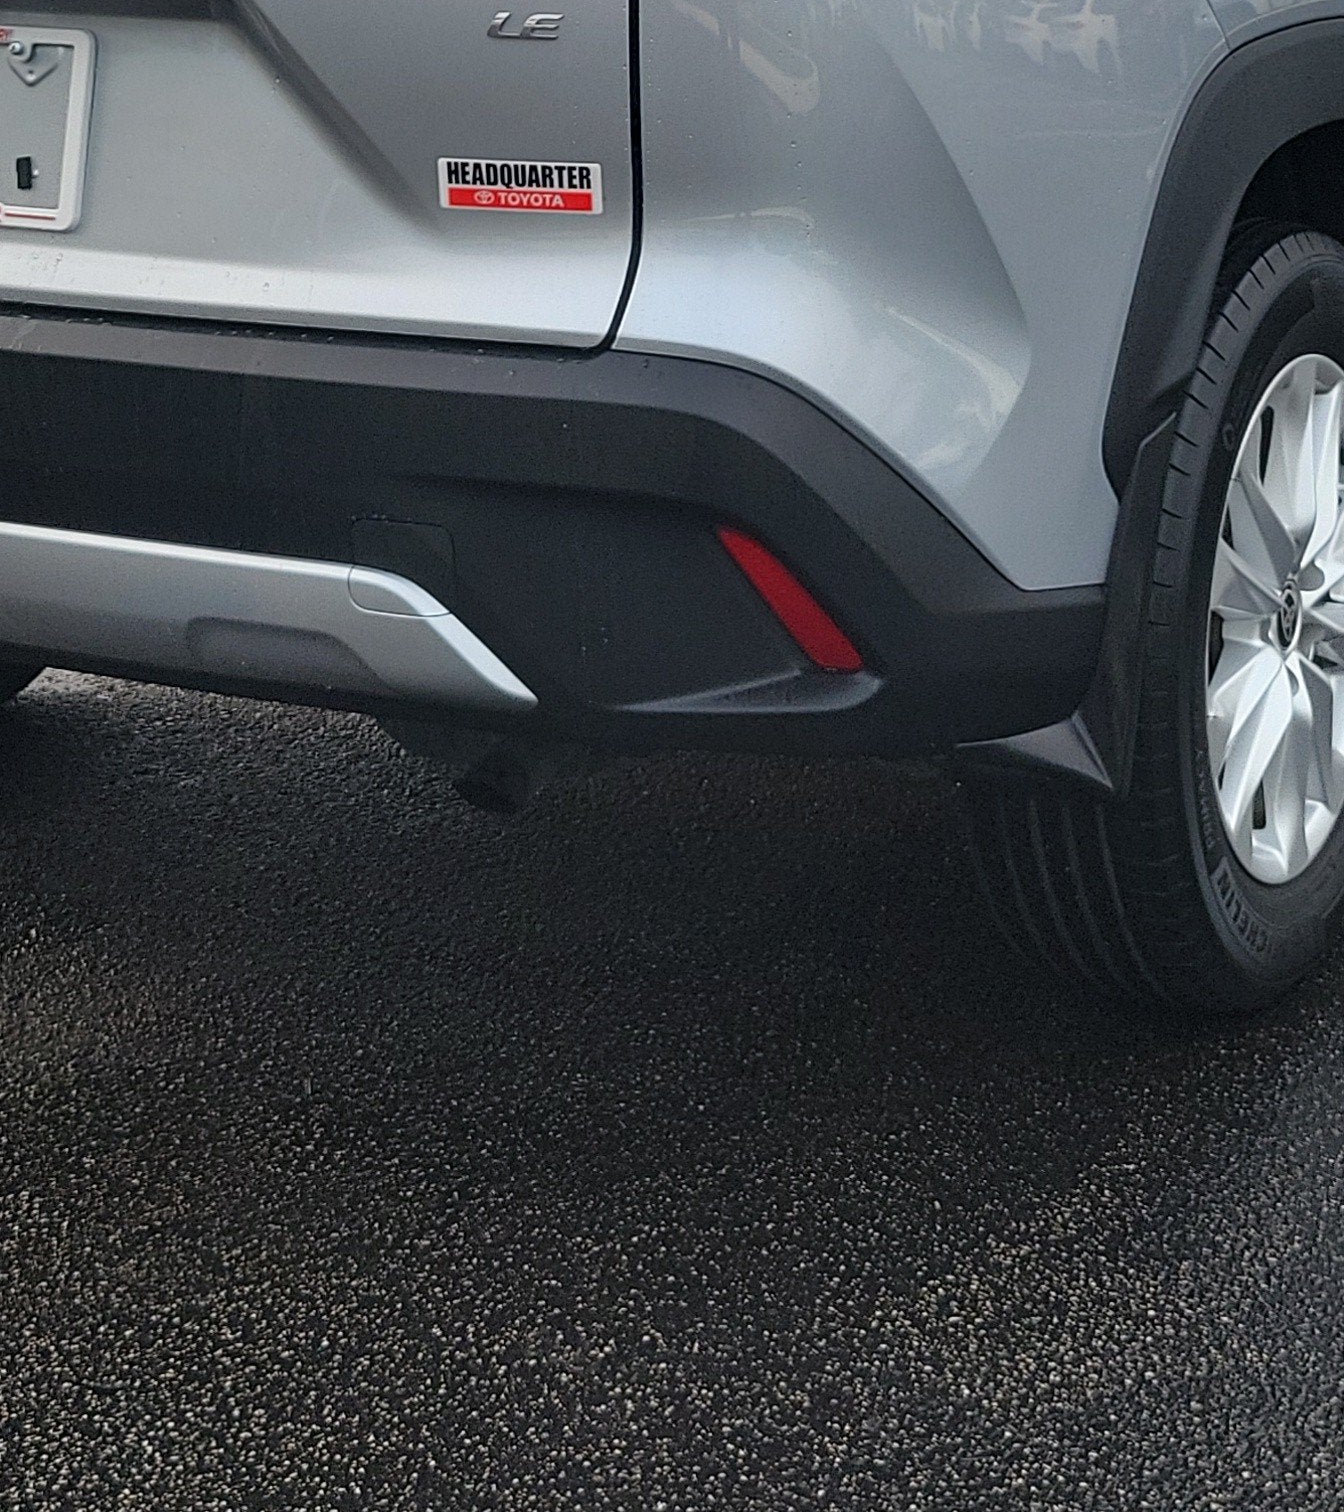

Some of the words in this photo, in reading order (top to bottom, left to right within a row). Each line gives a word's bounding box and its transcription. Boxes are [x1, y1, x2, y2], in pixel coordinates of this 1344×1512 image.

[486, 10, 565, 40] LE
[447, 161, 592, 189] HEADQUARTER
[497, 191, 565, 208] TOYOTA
